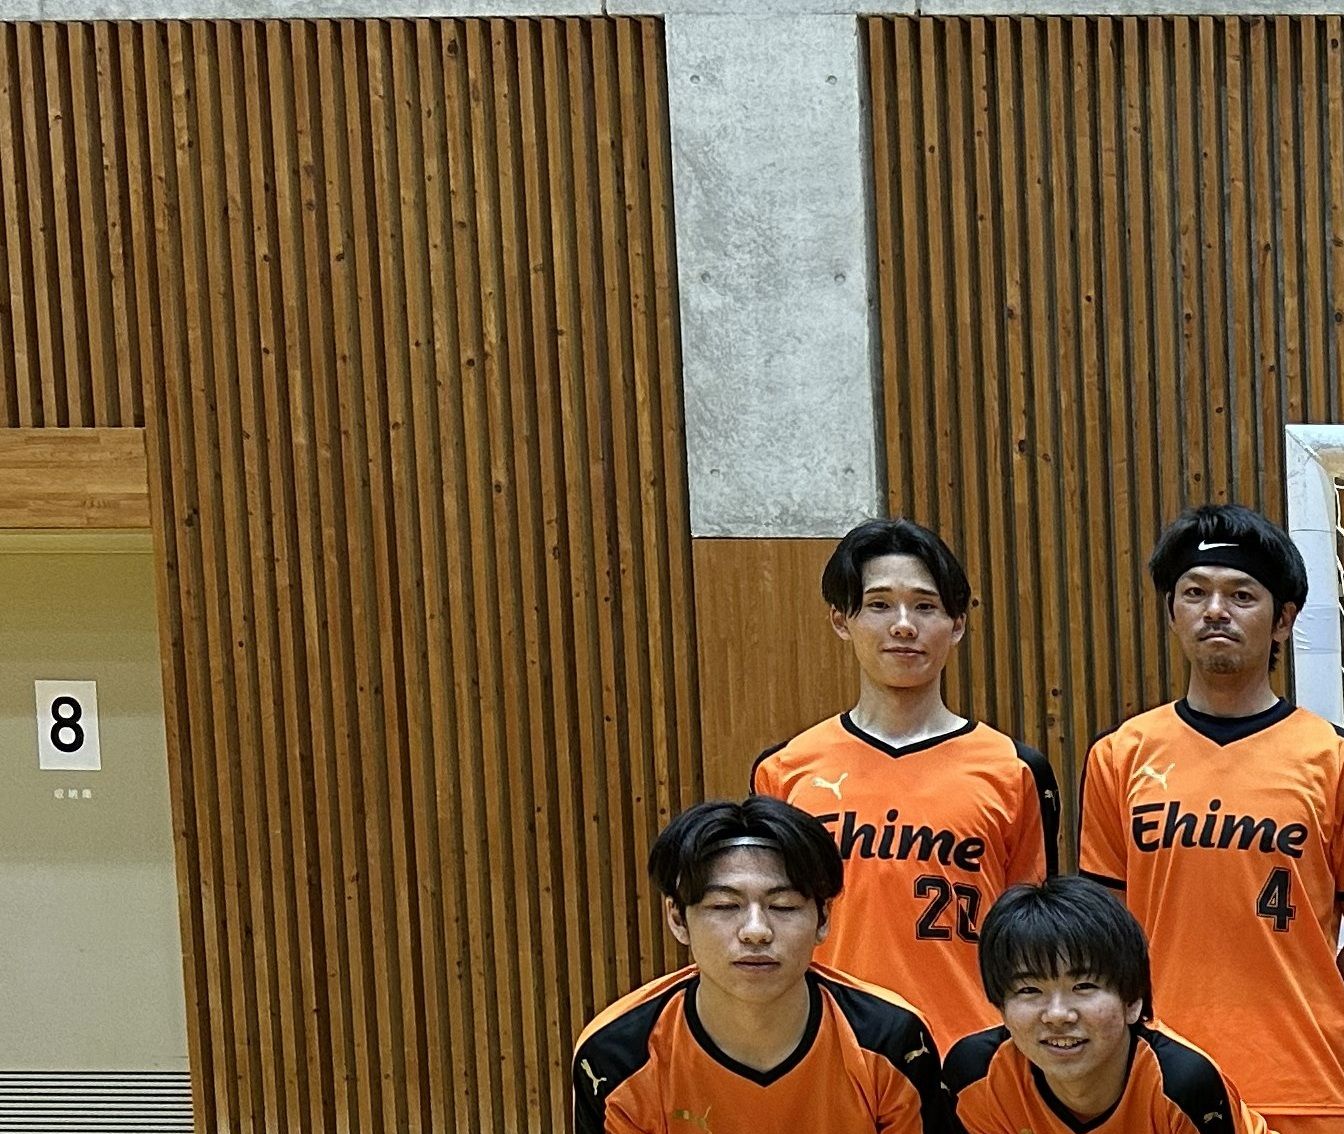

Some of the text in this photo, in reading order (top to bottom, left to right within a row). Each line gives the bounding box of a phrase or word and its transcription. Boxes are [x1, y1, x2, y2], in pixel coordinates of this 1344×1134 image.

[50, 696, 84, 752] 8
[1132, 799, 1308, 858] Ehime
[914, 874, 982, 943] 20
[1256, 867, 1296, 932] 4
